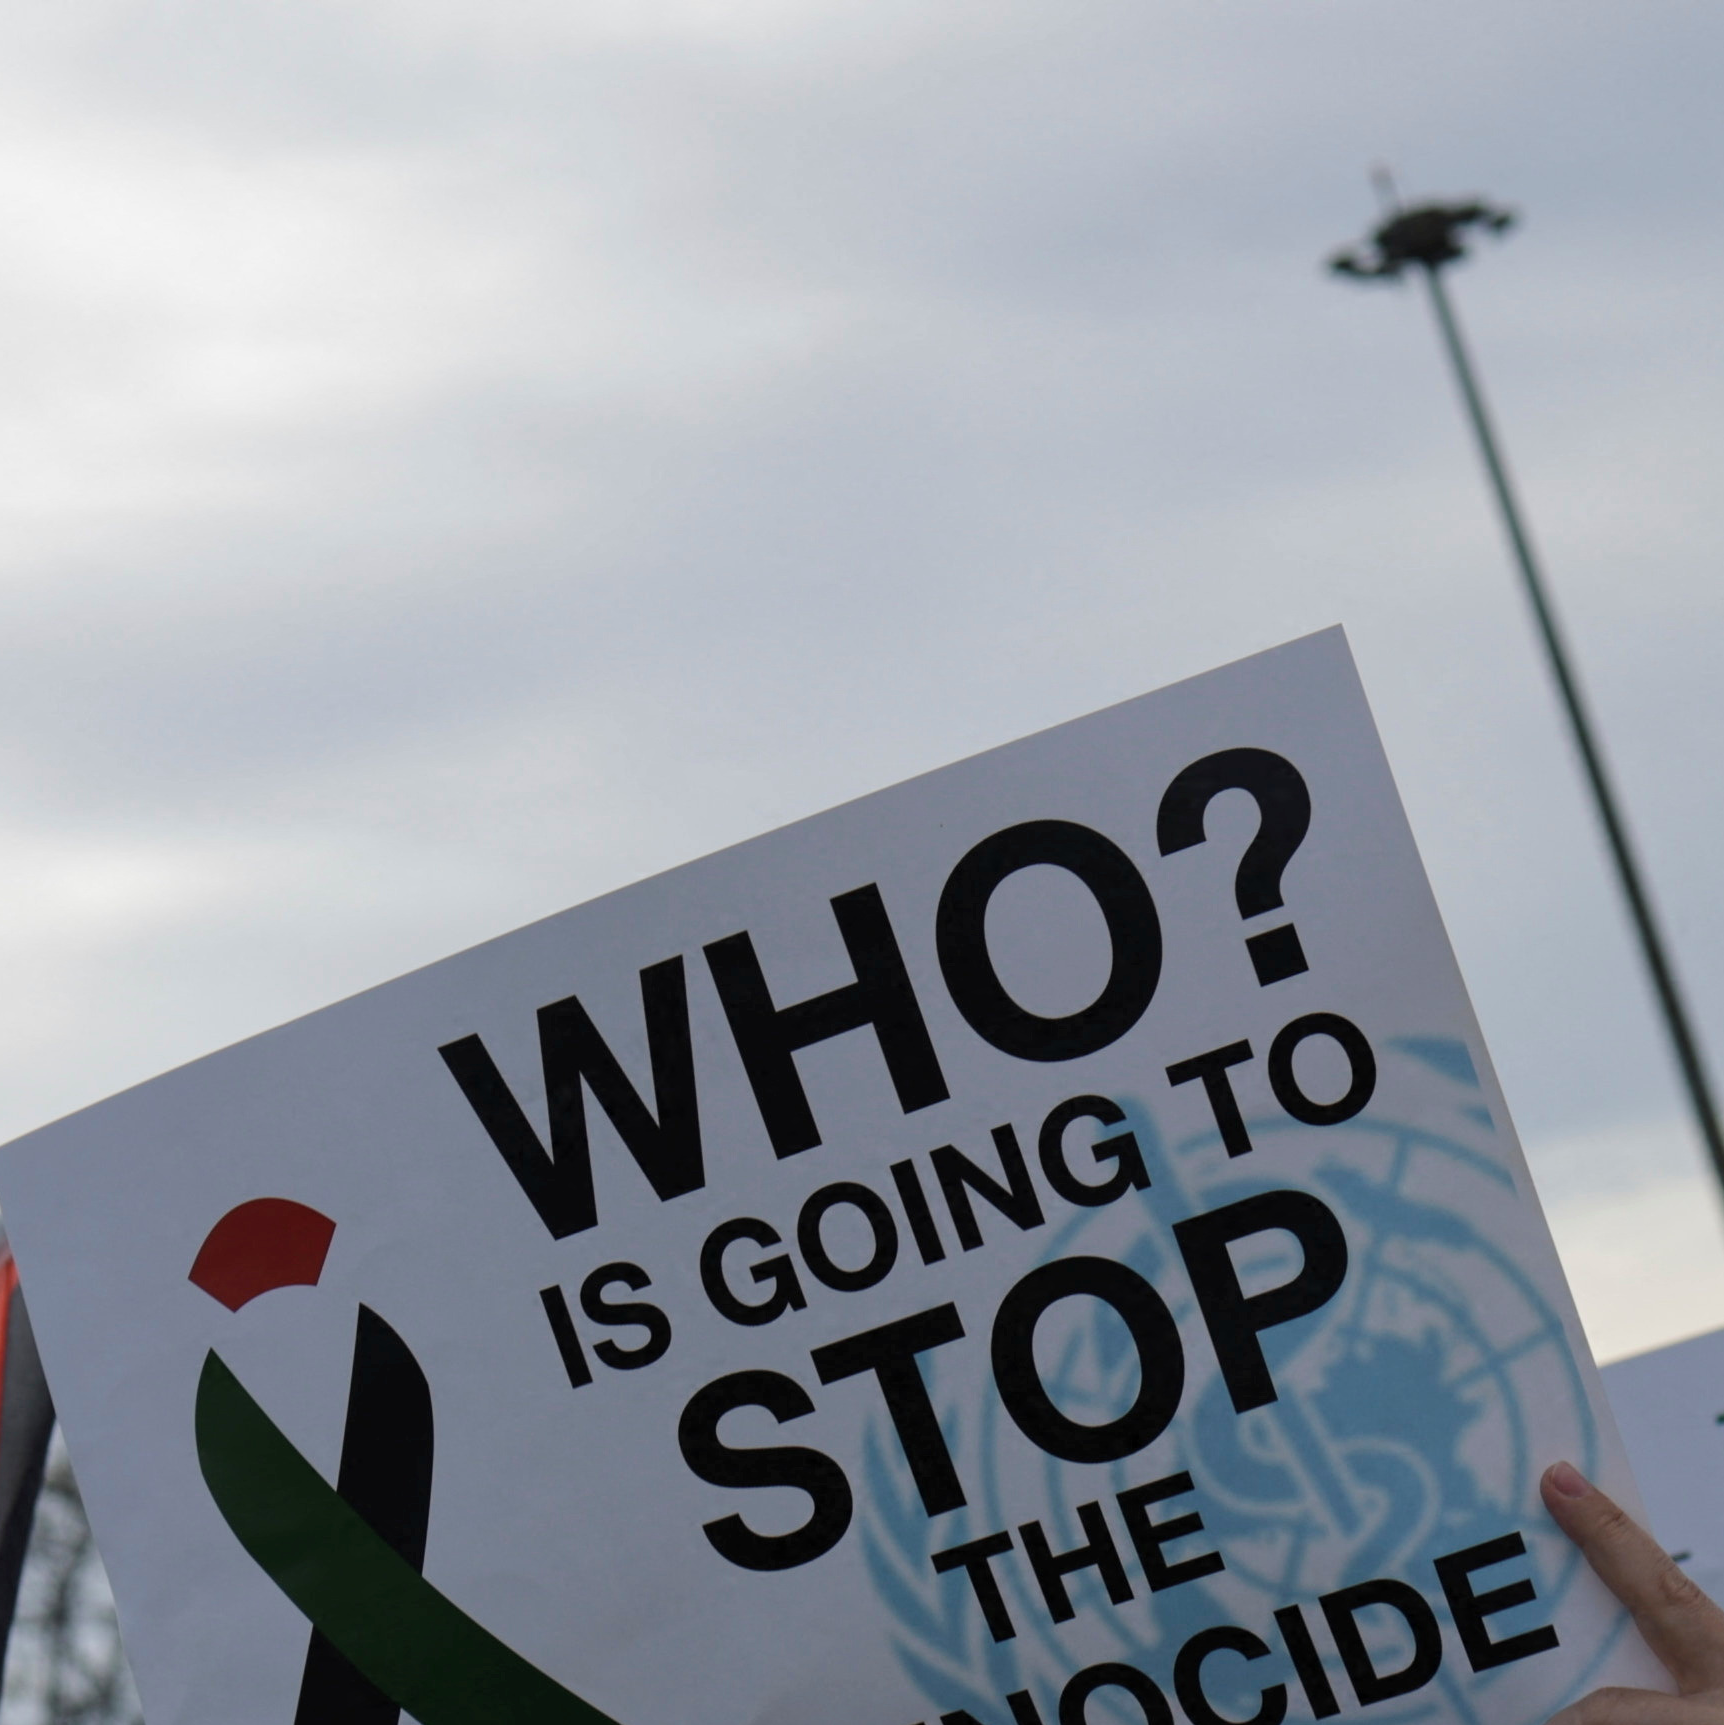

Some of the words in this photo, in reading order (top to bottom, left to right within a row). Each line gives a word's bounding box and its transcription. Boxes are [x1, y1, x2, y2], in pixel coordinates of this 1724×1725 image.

[439, 746, 1311, 1240] WHO?
[540, 1261, 671, 1387] IS
[699, 1095, 1149, 1327] GOING
[1167, 1012, 1377, 1158] TO
[678, 1189, 1347, 1571] STOP
[933, 1470, 1224, 1643] THE
